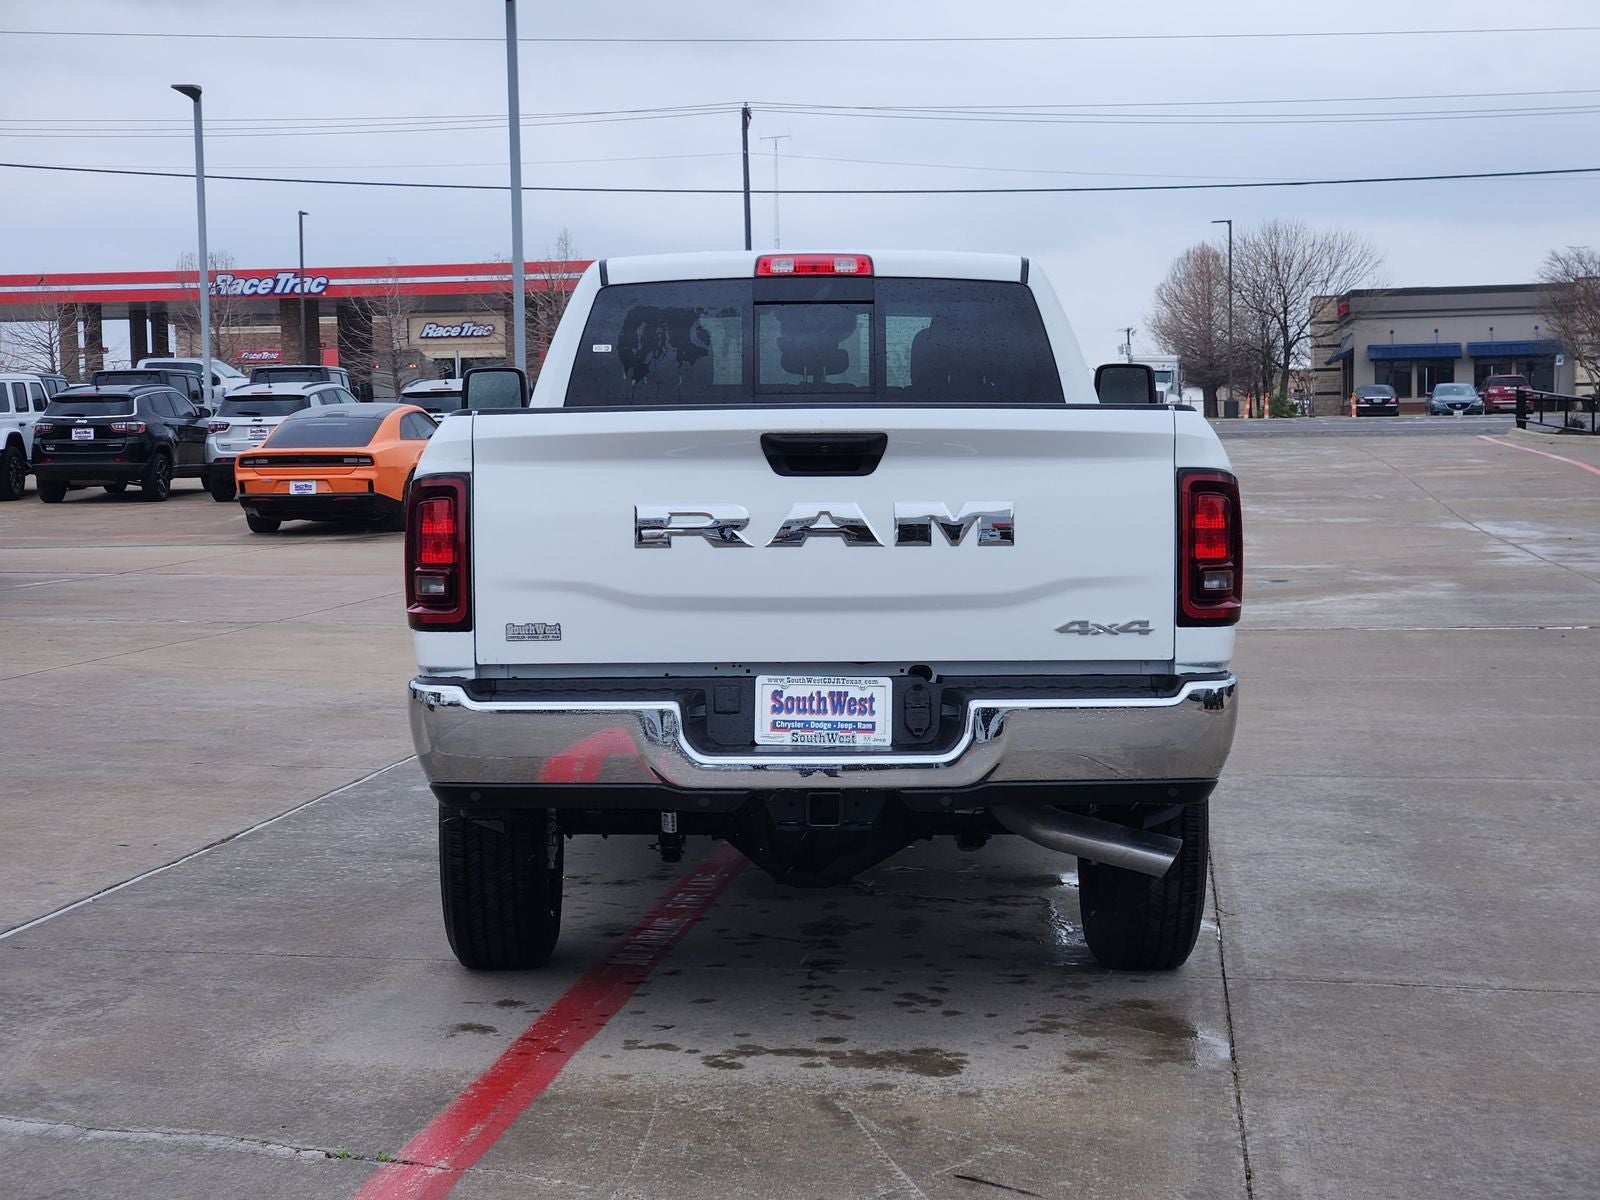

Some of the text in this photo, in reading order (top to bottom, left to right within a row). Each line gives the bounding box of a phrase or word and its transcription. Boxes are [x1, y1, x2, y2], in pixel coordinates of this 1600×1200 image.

[210, 271, 329, 296] RaceTrac
[420, 322, 494, 338] RaceTrac
[634, 502, 1015, 548] RAM
[506, 623, 561, 634] SouthWest
[1054, 620, 1155, 635] 4x4
[770, 689, 876, 716] SouthWest
[775, 721, 873, 731] Chrysler Dodge Jeep Ram
[791, 732, 857, 744] SouthWest
